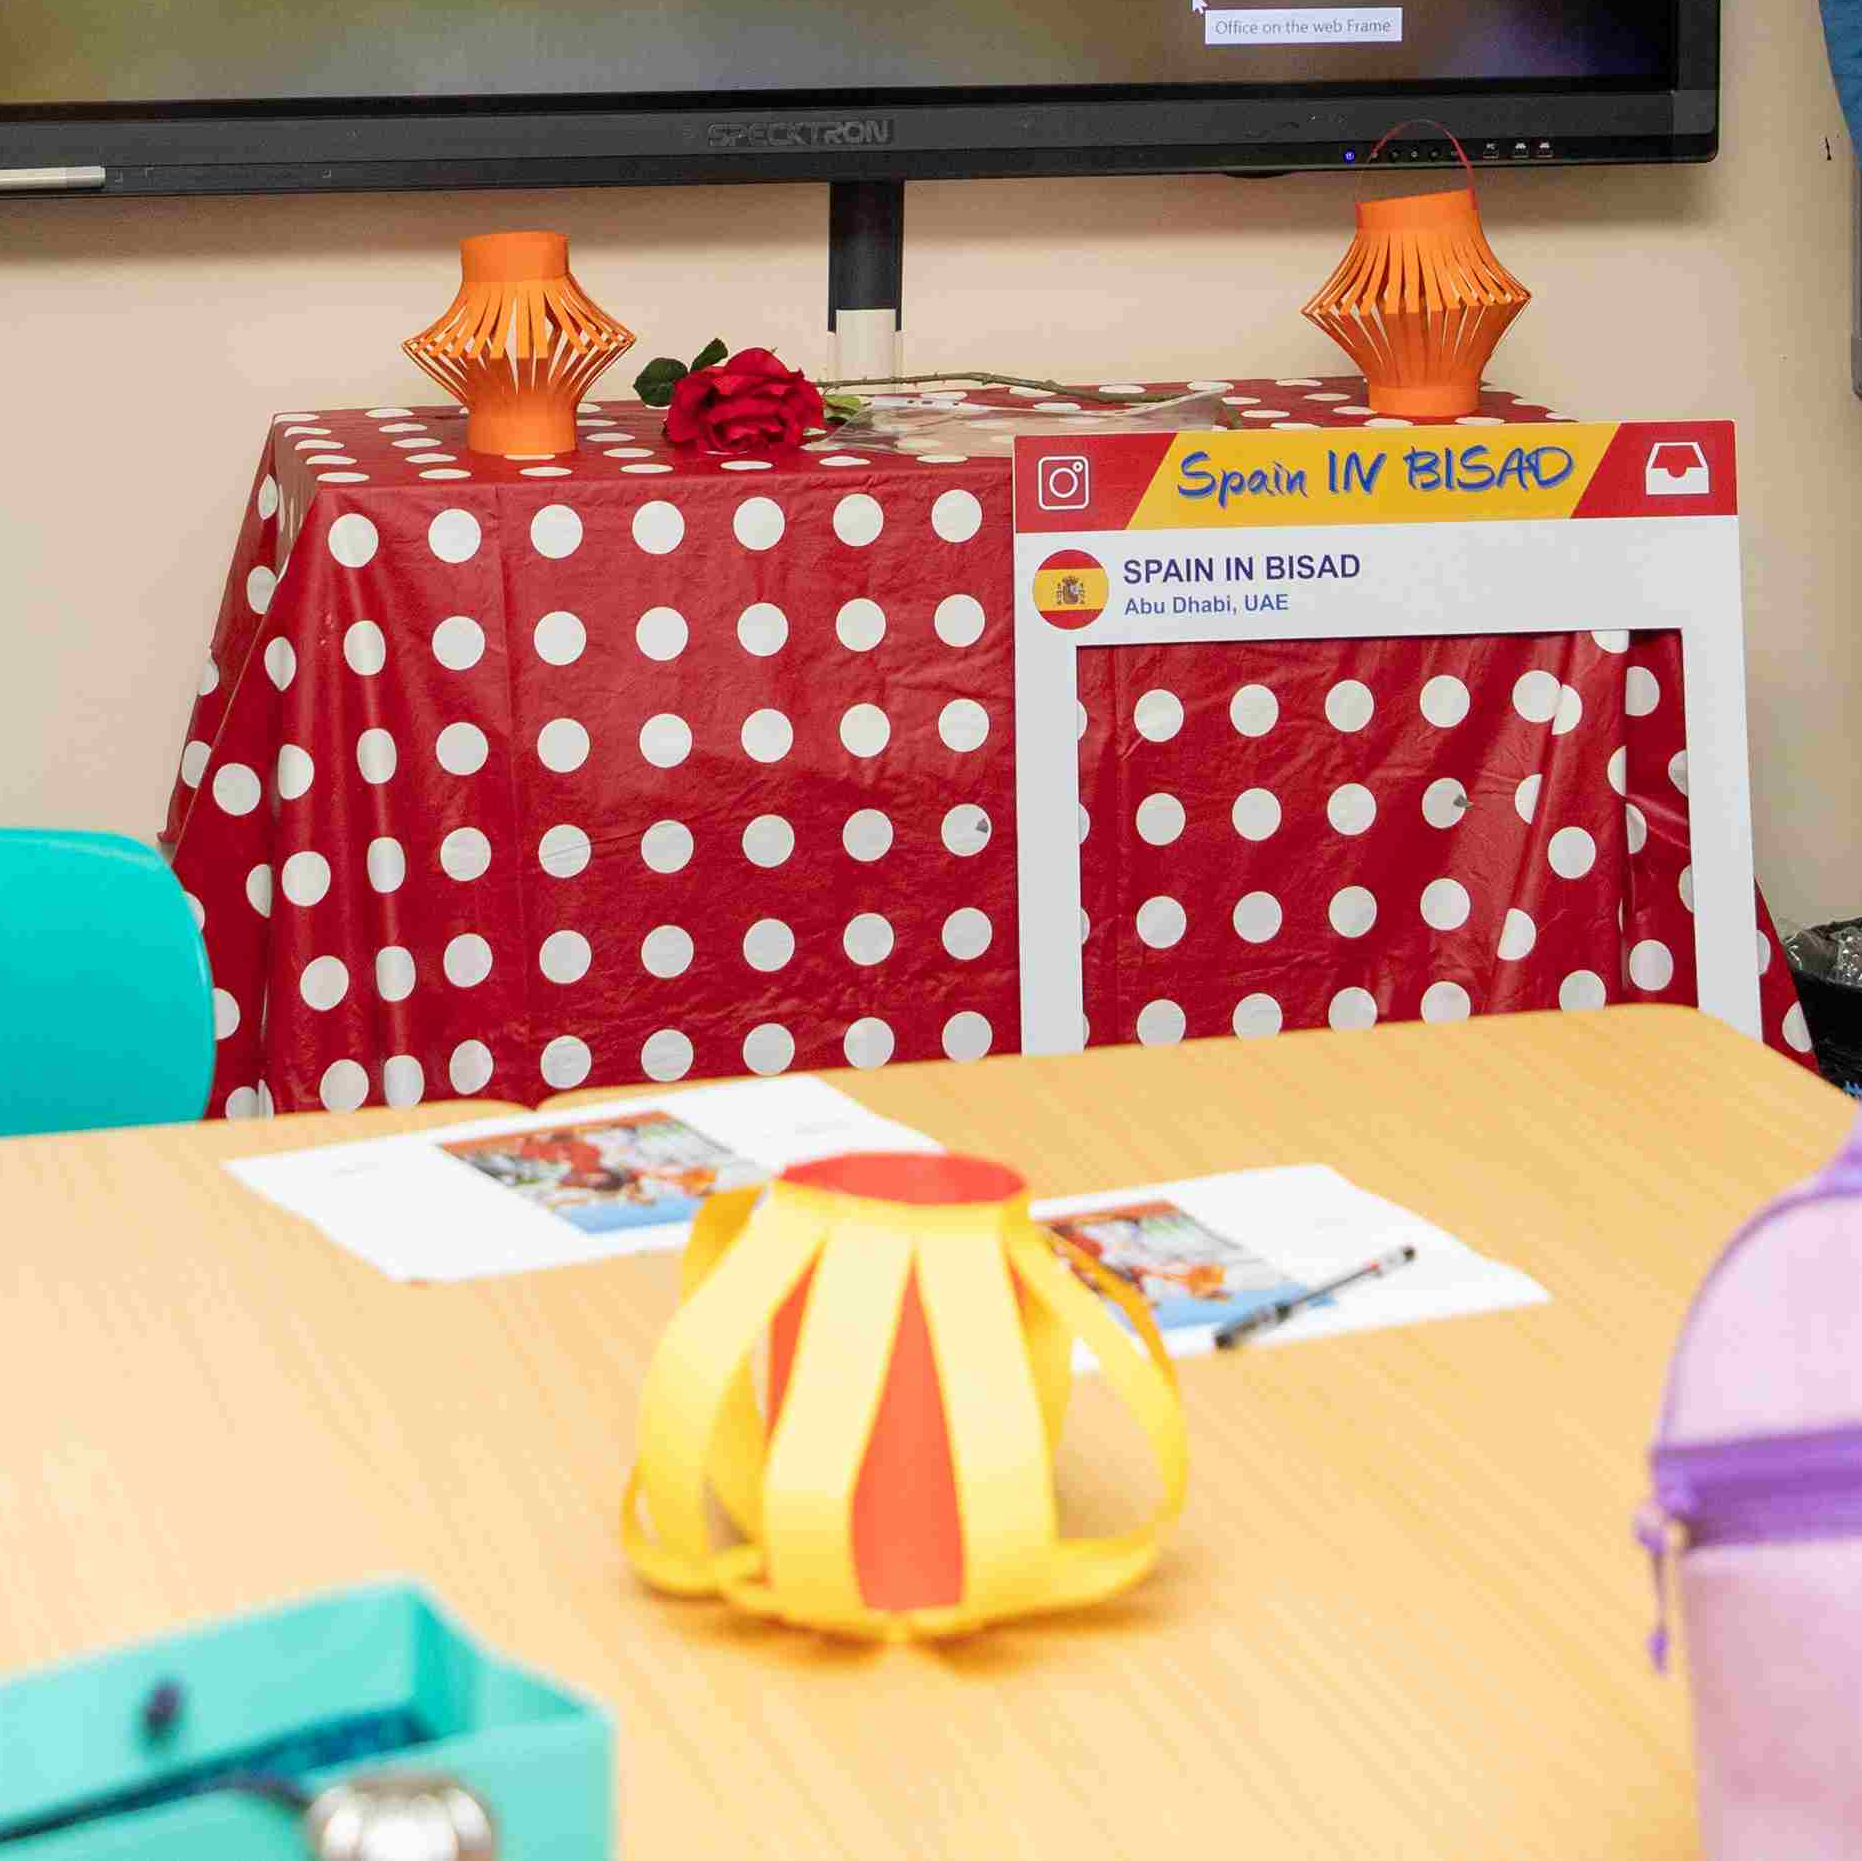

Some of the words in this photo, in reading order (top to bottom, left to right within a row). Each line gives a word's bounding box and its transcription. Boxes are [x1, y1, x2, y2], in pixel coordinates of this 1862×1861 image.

[1215, 19, 1257, 36] Office
[1262, 24, 1282, 35] on
[1285, 18, 1309, 34] the
[1312, 18, 1344, 34] web
[1347, 18, 1392, 34] Frame
[1178, 449, 1307, 507] Spain
[1328, 448, 1389, 496] IN
[1404, 445, 1575, 493] BISAD
[1123, 555, 1214, 585] SPAIN
[1224, 555, 1255, 582] IN
[1265, 553, 1361, 582] BISAD
[1124, 595, 1166, 617] Abu
[1172, 594, 1238, 617] Dhabi,
[1244, 593, 1289, 613] UAE
